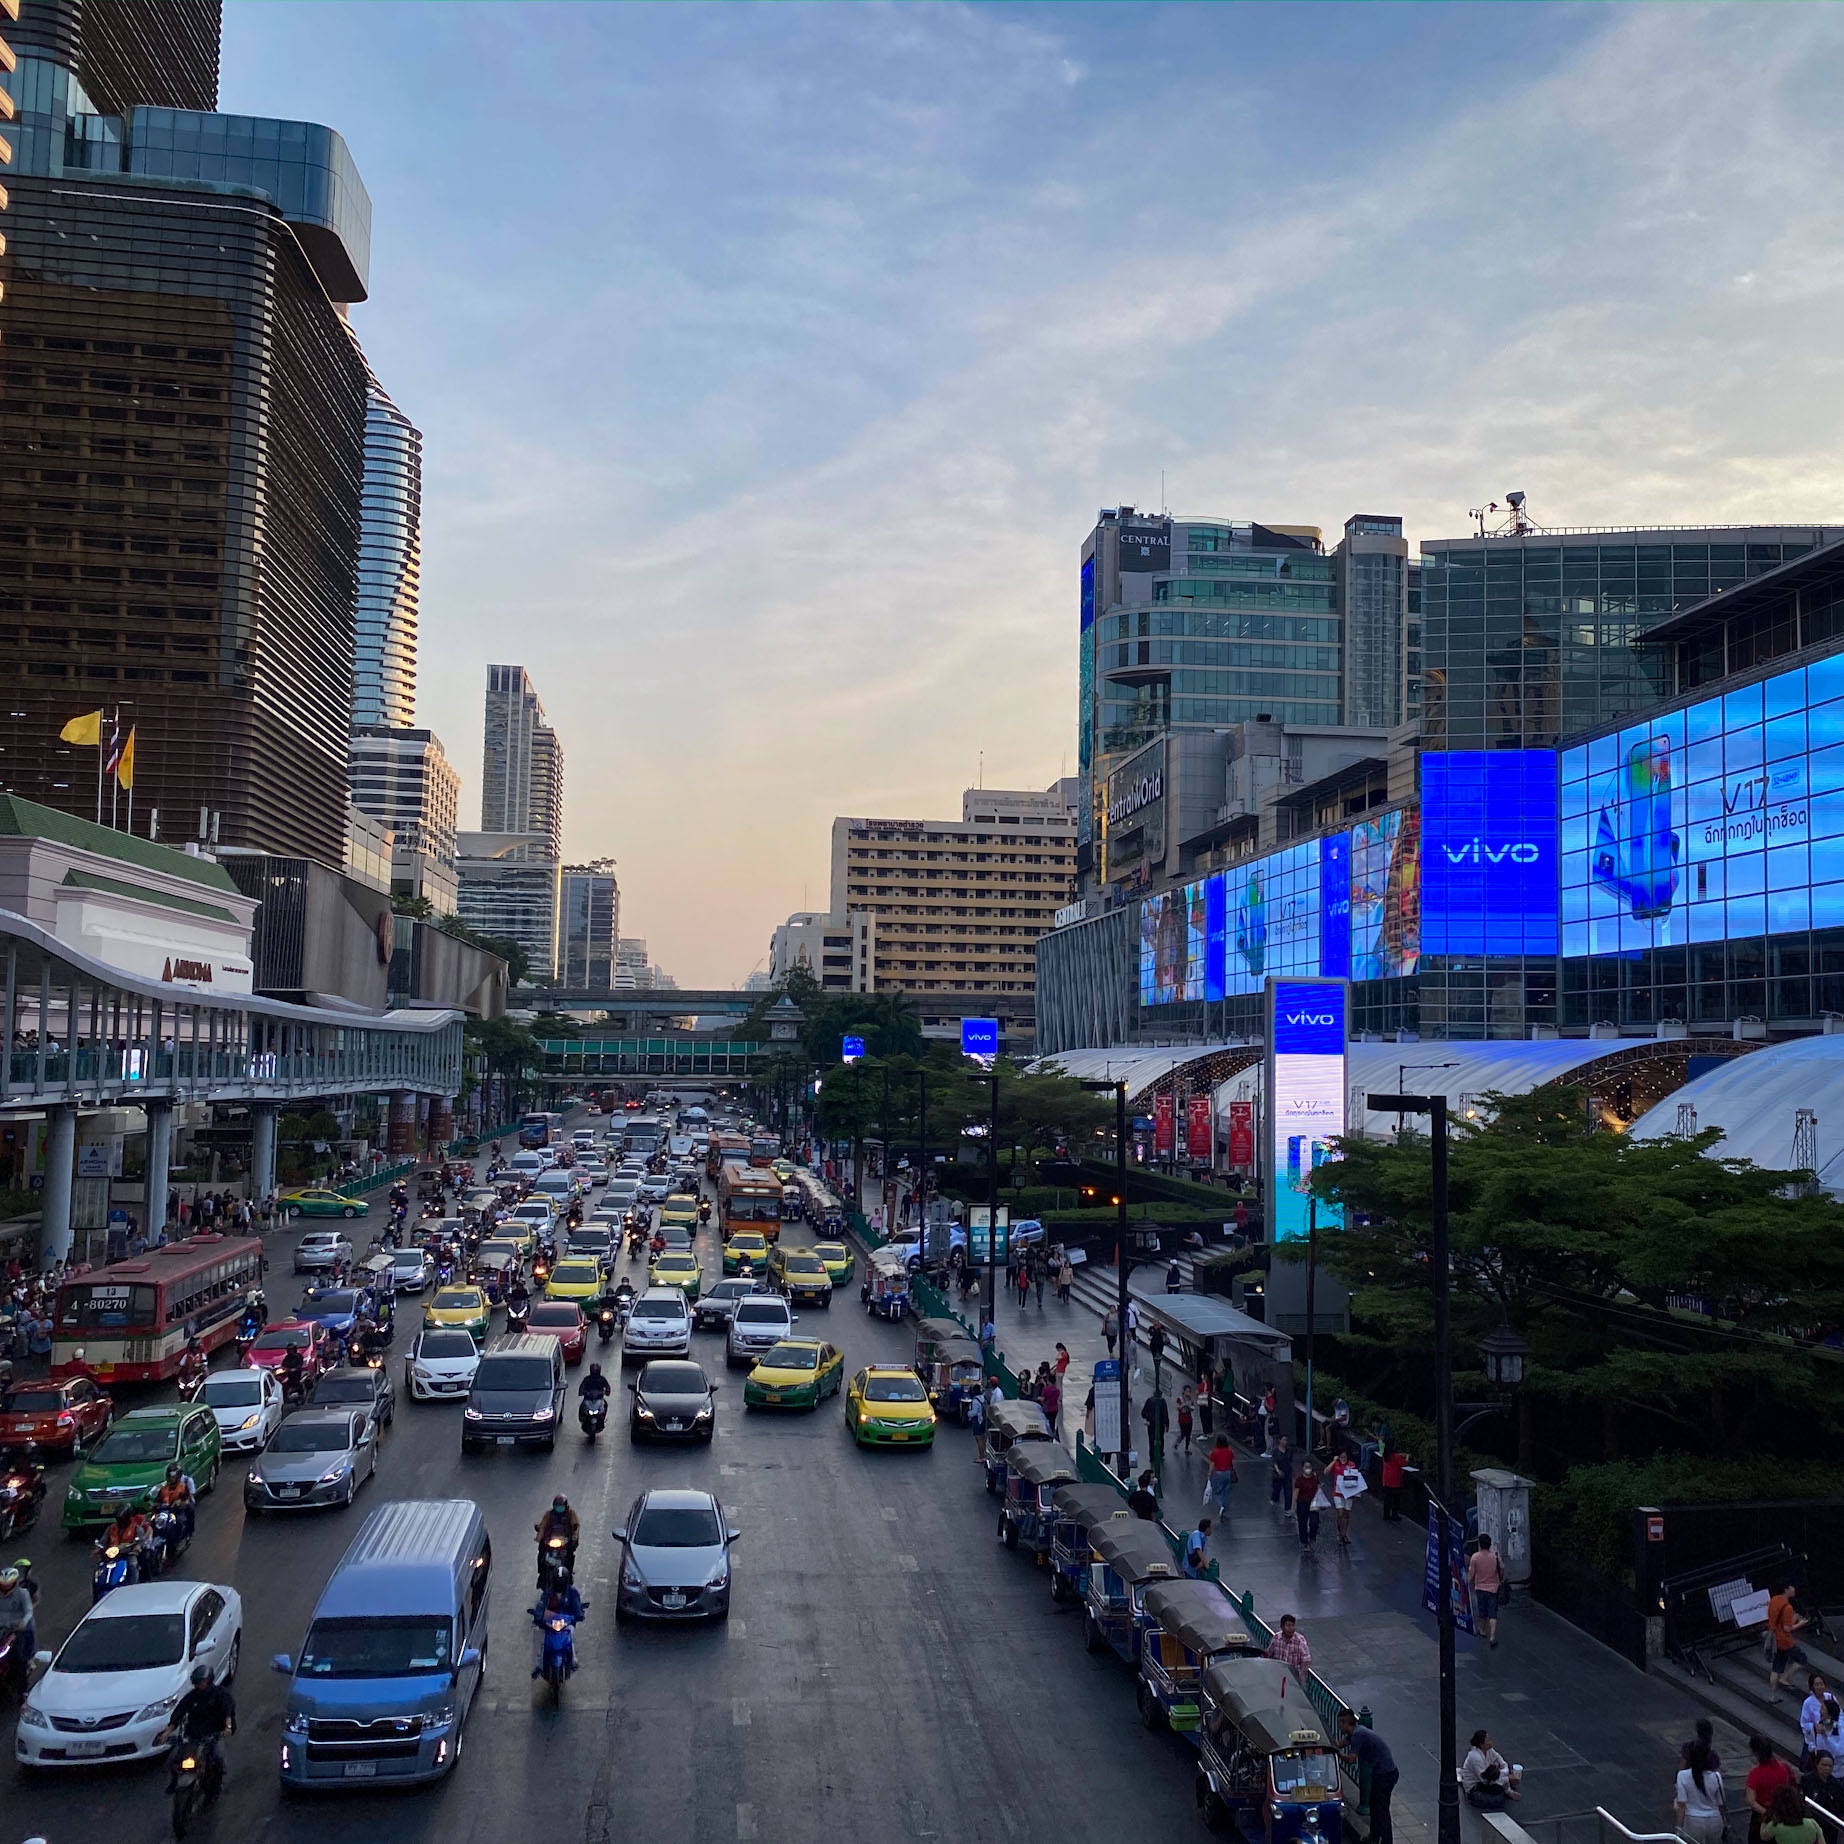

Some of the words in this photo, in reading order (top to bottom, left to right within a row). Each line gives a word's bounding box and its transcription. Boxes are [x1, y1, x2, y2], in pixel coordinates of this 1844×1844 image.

[1121, 535, 1170, 545] CENTRAL
[1720, 776, 1770, 814] V17
[1442, 837, 1539, 863] vivo
[1328, 898, 1349, 916] vivo
[1286, 1011, 1334, 1025] vivo
[1293, 1100, 1318, 1109] V17
[106, 1287, 117, 1296] 13
